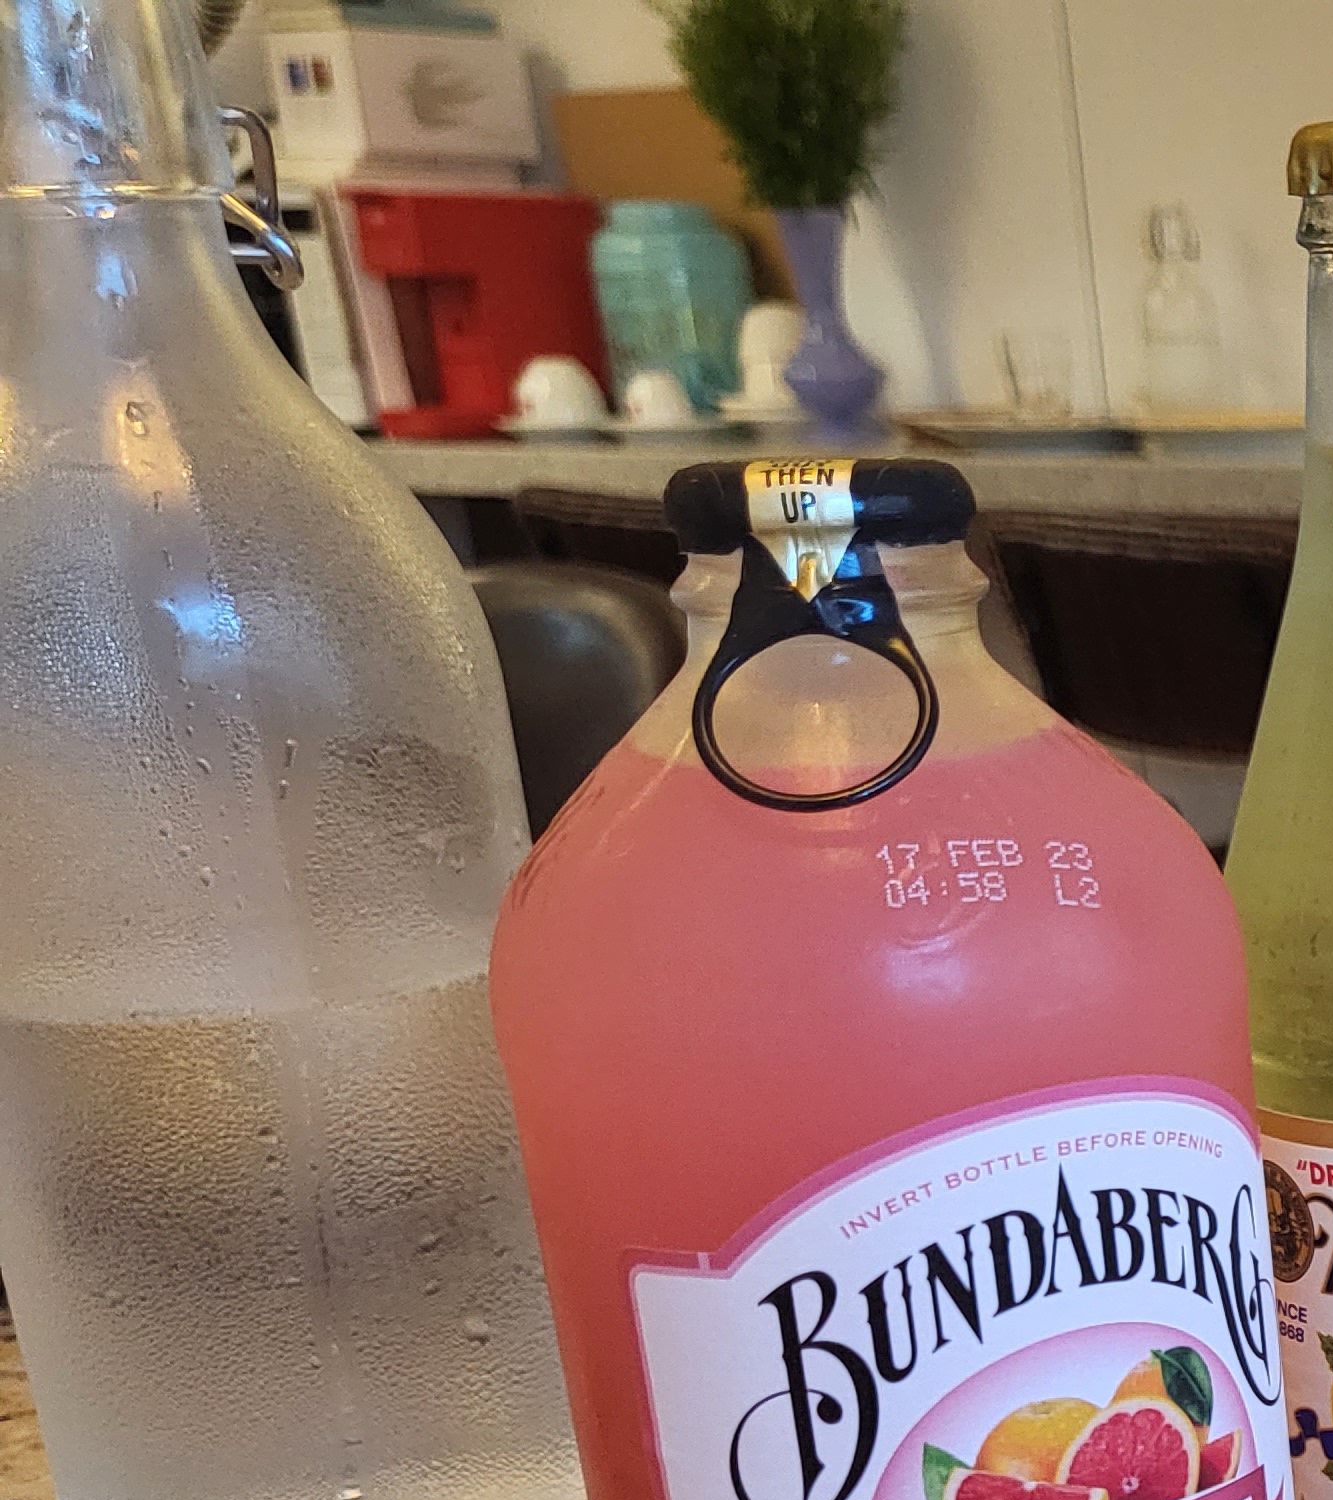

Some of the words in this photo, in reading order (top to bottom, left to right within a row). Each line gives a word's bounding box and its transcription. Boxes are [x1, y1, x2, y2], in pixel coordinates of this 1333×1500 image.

[760, 468, 835, 488] THEN
[781, 491, 816, 523] UP
[876, 843, 919, 875] 17
[947, 839, 1023, 867] FEB
[1046, 841, 1093, 871] 23
[884, 871, 1007, 908] 04:58
[1054, 874, 1101, 909] L2
[839, 1182, 933, 1240] INVERT
[944, 1146, 1048, 1190] BOTTLE
[1057, 1130, 1147, 1157] BEFORE
[1153, 1130, 1224, 1159] OPENING
[1279, 1322, 1305, 1343] 868
